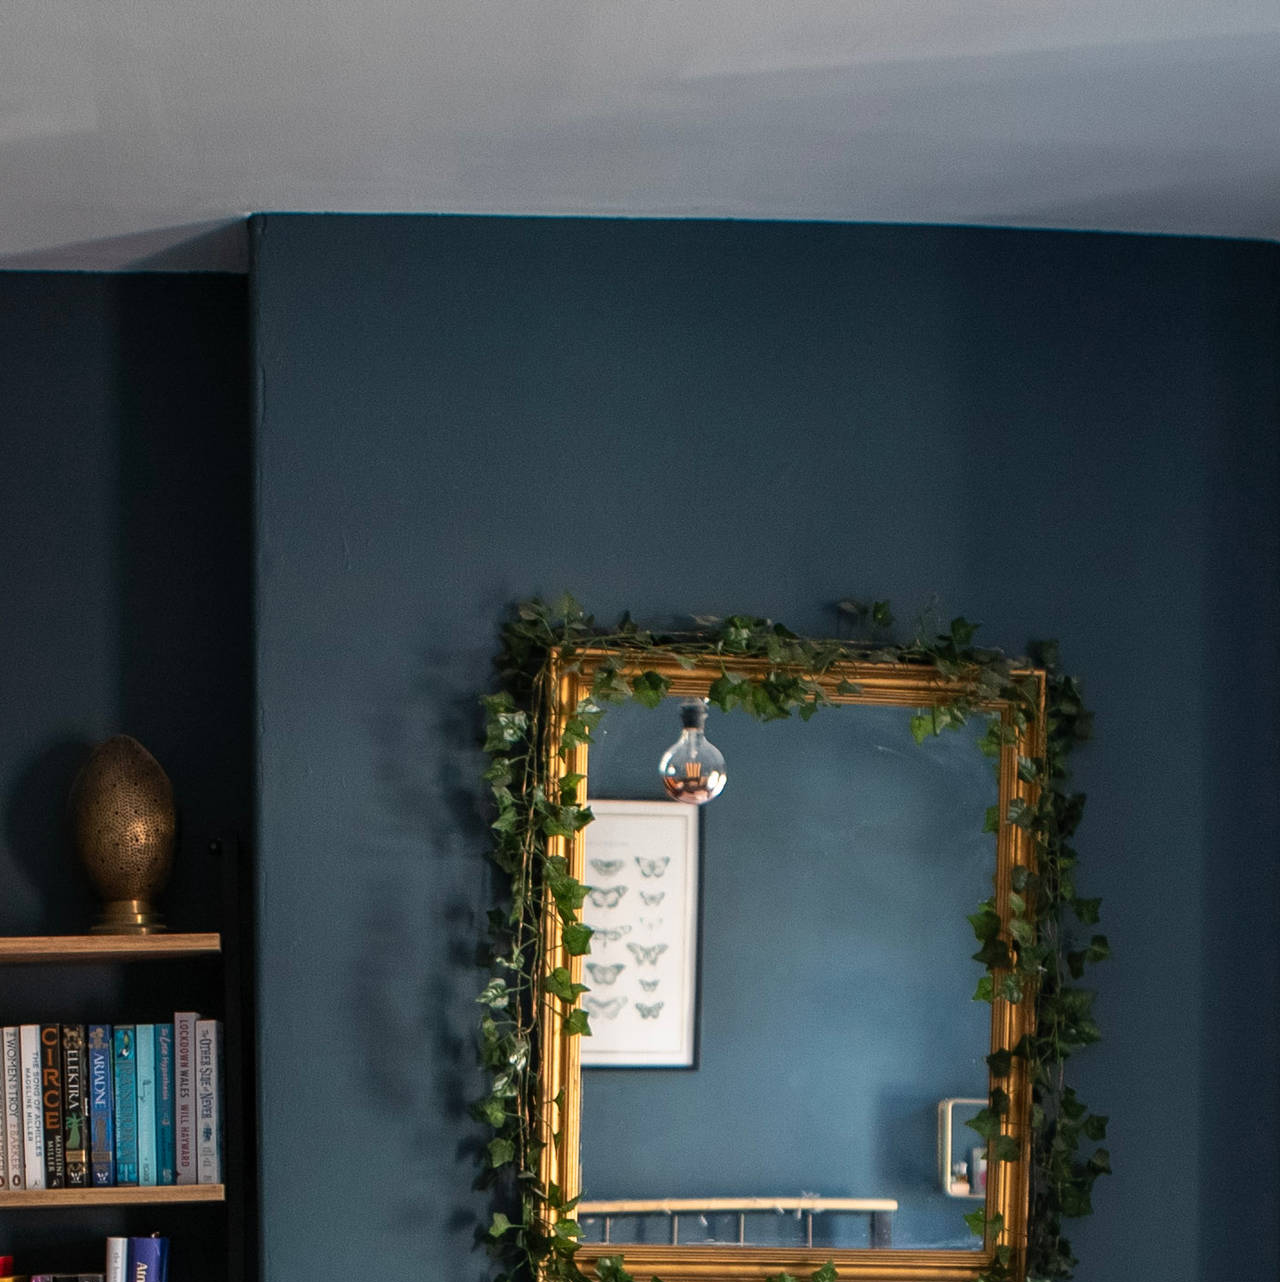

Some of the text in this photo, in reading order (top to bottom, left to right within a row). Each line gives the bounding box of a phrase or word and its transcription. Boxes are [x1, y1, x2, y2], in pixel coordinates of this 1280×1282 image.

[7, 1040, 18, 1118] WOMEN TROY
[41, 1028, 62, 1129] CIRCE
[67, 1050, 79, 1109] ELEKTRA
[94, 1052, 106, 1110] ARIADNE
[180, 1019, 190, 1098] LOCKDOWN WALES
[200, 1039, 213, 1119] OTHER NEVER
[10, 1131, 20, 1170] BARKER
[181, 1104, 191, 1167] WILL HAYWARD
